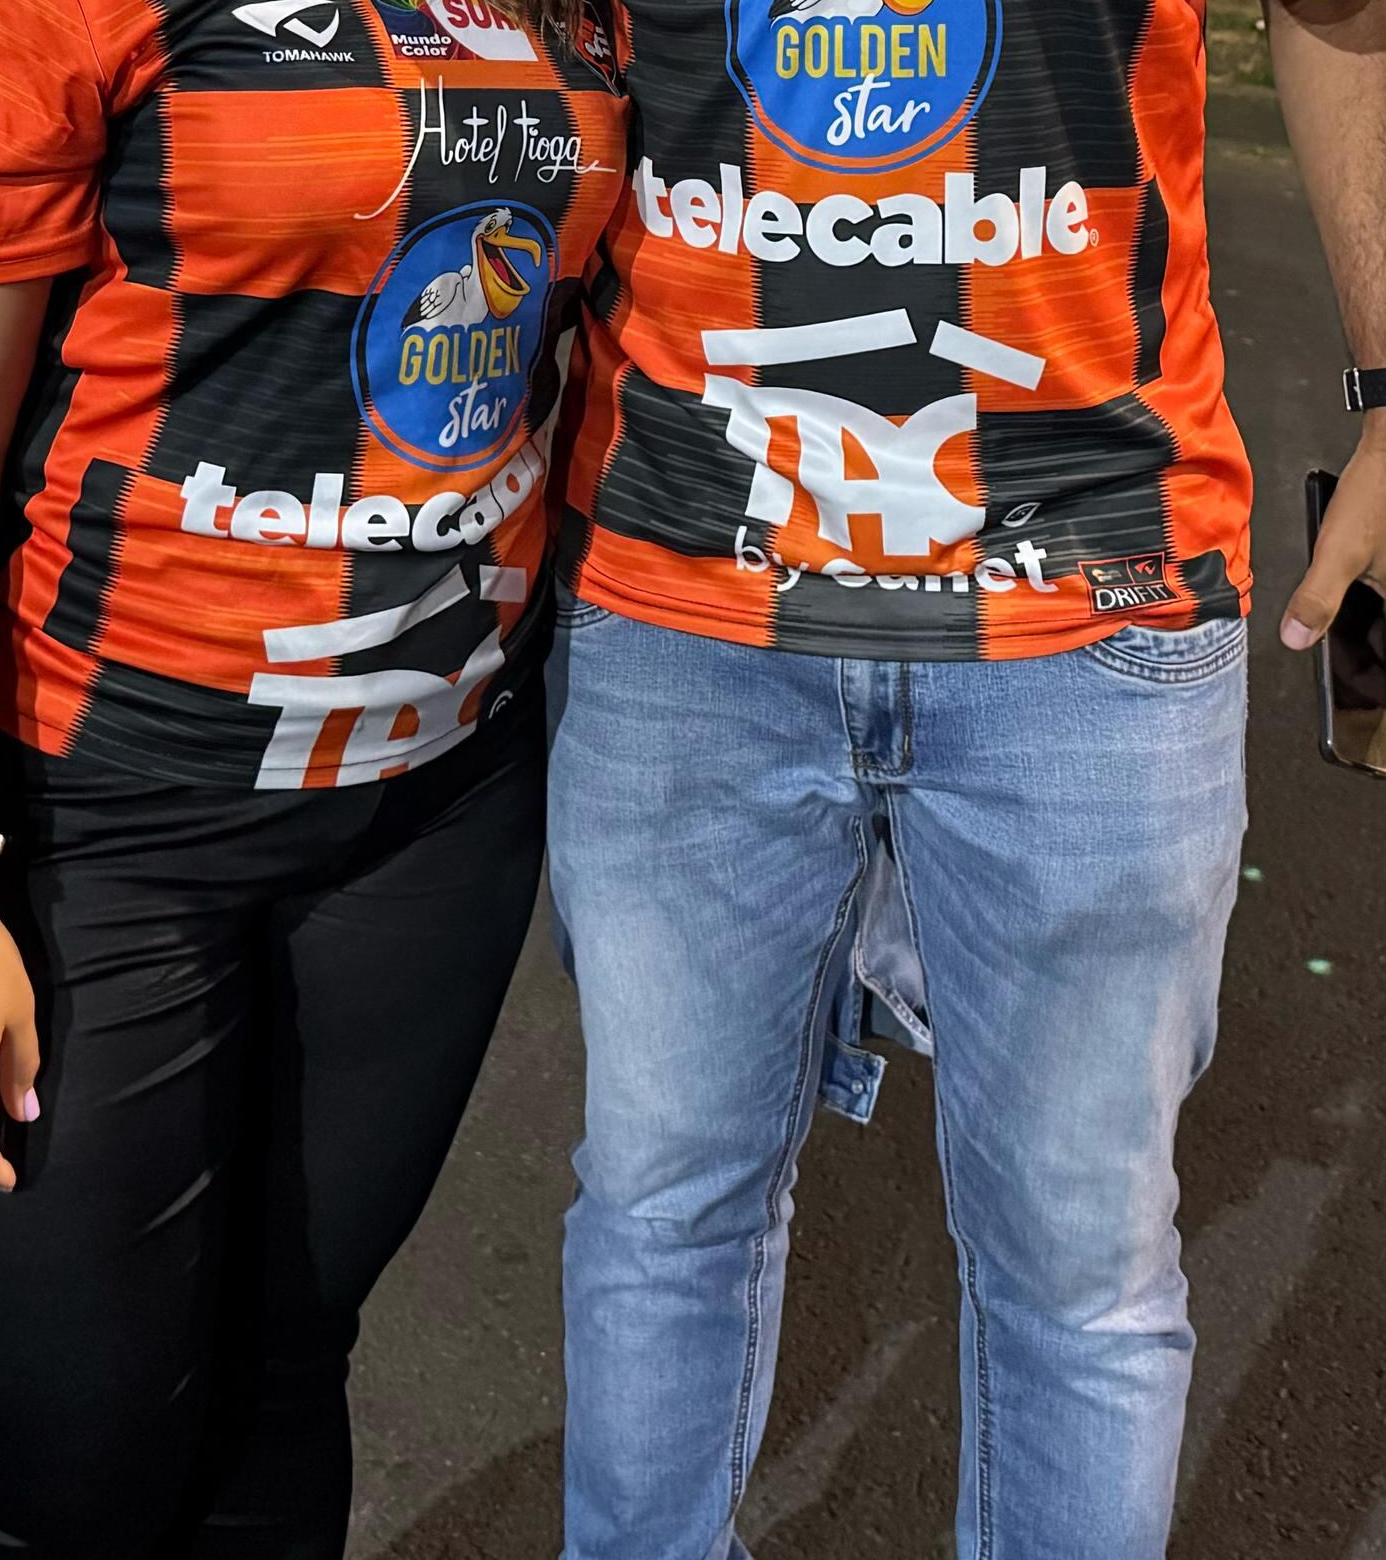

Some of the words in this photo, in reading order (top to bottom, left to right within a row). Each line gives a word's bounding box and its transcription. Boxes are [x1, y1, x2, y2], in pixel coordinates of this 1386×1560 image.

[262, 49, 355, 63] TOMAHAWK
[390, 33, 452, 46] Mundo
[401, 45, 448, 56] Color
[774, 22, 947, 80] GOLDEN
[826, 73, 931, 147] star
[354, 75, 507, 220] Hotel
[631, 155, 1089, 268] telecable
[398, 324, 522, 386] GOLDEN
[438, 372, 507, 448] star
[734, 525, 809, 591] by
[1095, 584, 1168, 610] DRIFIT
